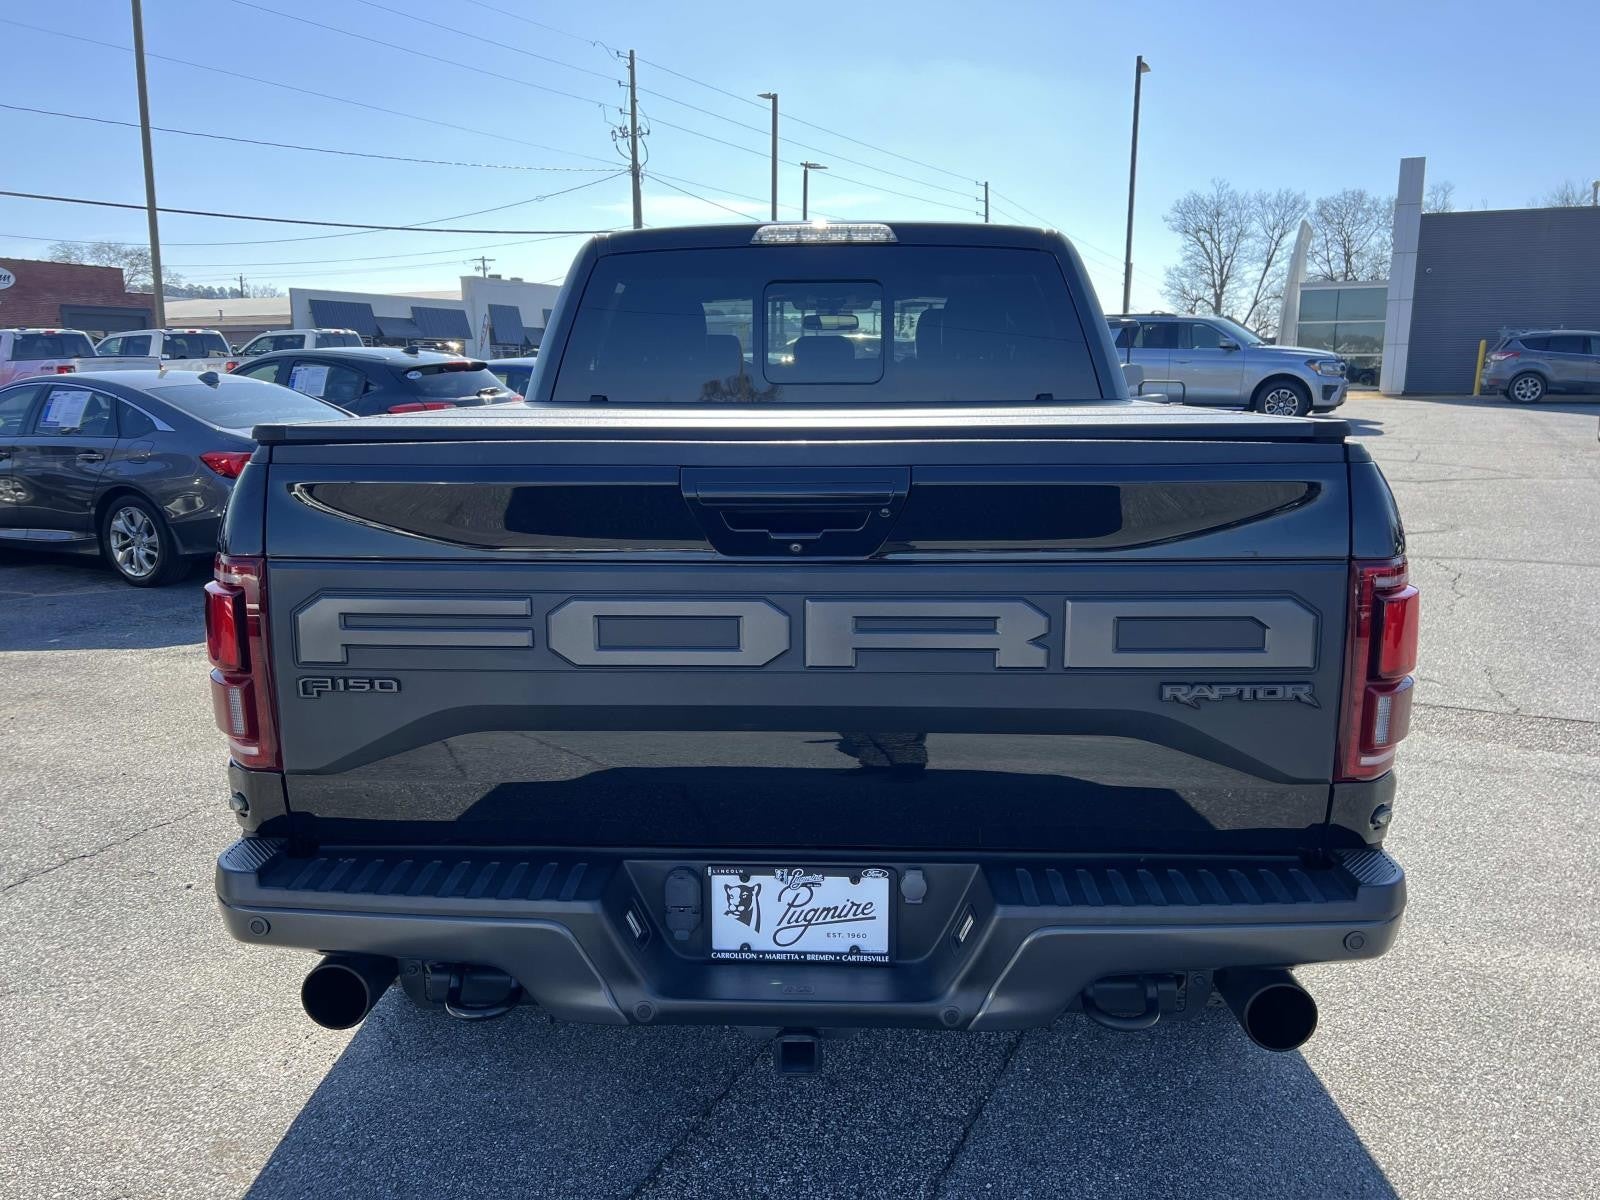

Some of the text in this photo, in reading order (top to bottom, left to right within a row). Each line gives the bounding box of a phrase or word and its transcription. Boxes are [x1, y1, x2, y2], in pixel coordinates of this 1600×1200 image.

[295, 596, 1319, 669] FORD
[1160, 682, 1321, 709] RAPTOR
[773, 886, 877, 947] Pugmire
[711, 952, 757, 960] CARROLLTON
[764, 953, 799, 961] MARIETTA
[841, 955, 889, 963] CARTERSVILLE
